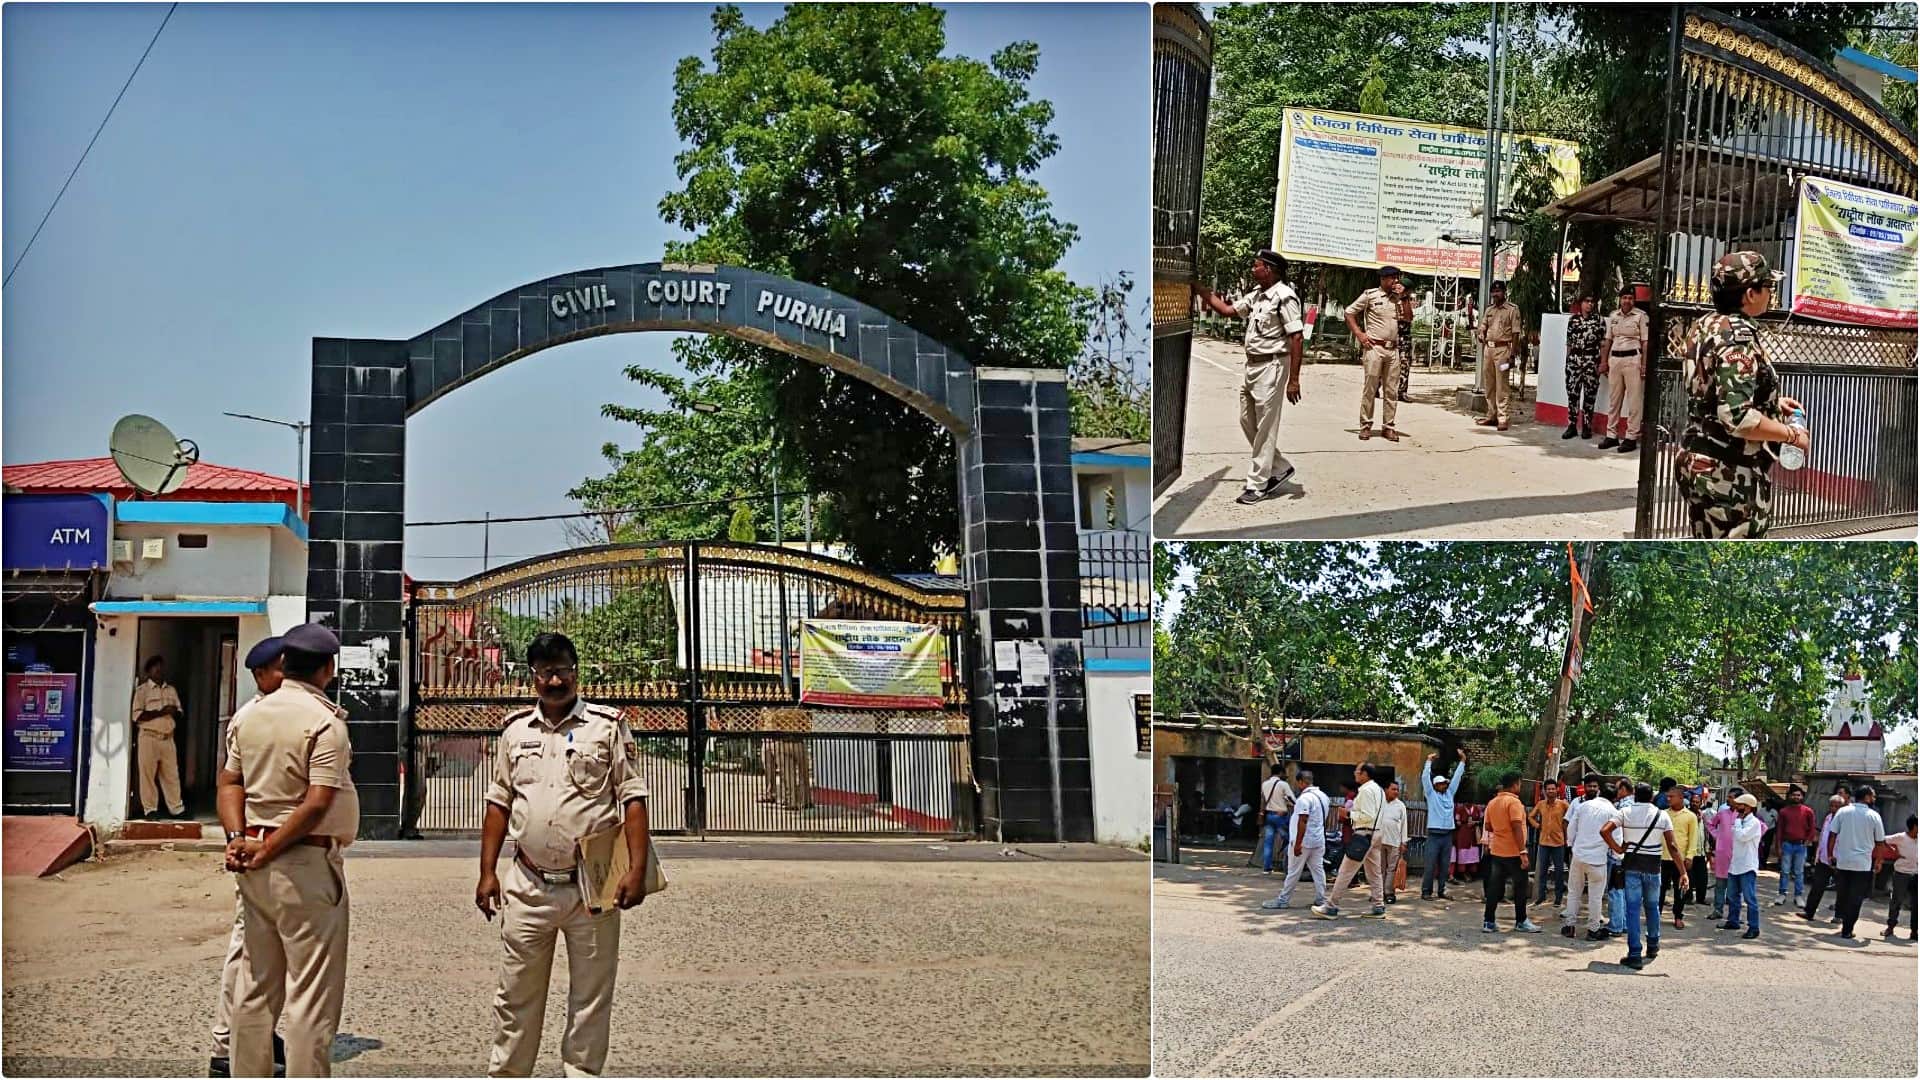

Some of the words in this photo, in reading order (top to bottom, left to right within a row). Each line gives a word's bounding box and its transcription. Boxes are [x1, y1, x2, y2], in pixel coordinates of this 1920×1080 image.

[1312, 115, 1352, 131] जिला
[1356, 121, 1404, 137] विधिक
[1408, 127, 1438, 141] सेवा
[1866, 210, 1885, 226] लोक
[551, 284, 617, 318] CIVIL
[647, 280, 731, 305] COURT
[757, 290, 847, 338] PURNIA
[50, 528, 90, 545] ATM
